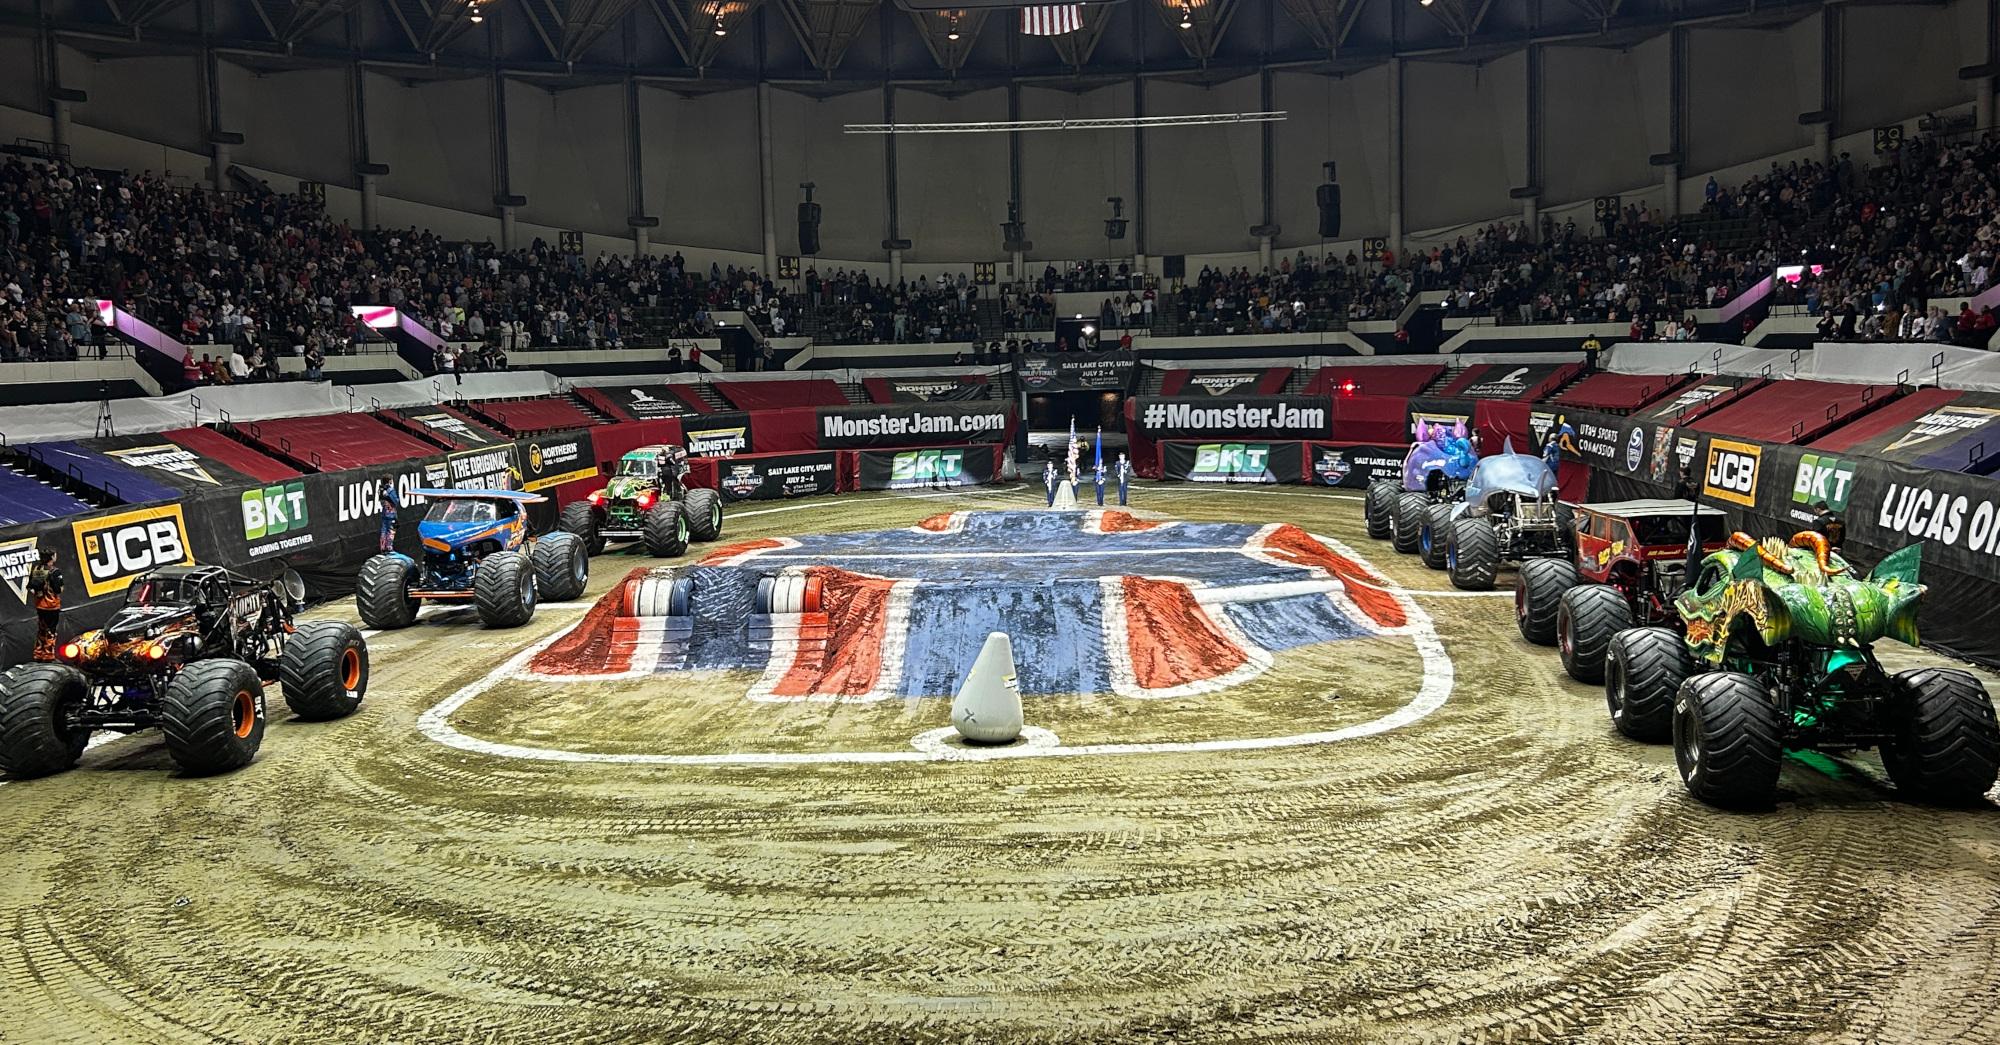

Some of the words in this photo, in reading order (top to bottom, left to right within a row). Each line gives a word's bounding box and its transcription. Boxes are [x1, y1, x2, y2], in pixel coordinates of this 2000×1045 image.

[315, 183, 323, 194] K
[562, 232, 569, 243] K
[573, 232, 580, 244] L
[1365, 240, 1373, 250] N
[780, 257, 786, 268] L
[790, 258, 798, 268] M
[976, 264, 984, 274] M
[986, 264, 994, 274] M
[1191, 376, 1255, 385] MONSTER
[1143, 403, 1325, 429] #MonsterJam
[1914, 413, 1990, 429] MONSTER
[824, 412, 1005, 438] MonsterJam.com
[1597, 428, 1618, 443] SPORTS
[542, 442, 578, 459] NORTHERN
[689, 437, 746, 453] MONSTER
[1578, 438, 1616, 459] COMMISSION
[120, 450, 200, 467] MONSTER
[452, 458, 470, 480] THE
[470, 451, 508, 476] ORIGINAL
[893, 453, 962, 475] BKT
[1196, 449, 1268, 468] BKT
[1370, 458, 1386, 466] LAKE
[1386, 459, 1403, 467] CITY,
[425, 470, 449, 482] MONSTER
[768, 468, 782, 476] SALT
[783, 467, 800, 475] LAKE
[800, 465, 816, 473] CITY,
[816, 463, 832, 471] UTAH
[1709, 452, 1755, 492] JCB
[744, 477, 763, 486] FINALS
[786, 476, 800, 485] JULY
[891, 481, 924, 489] GROWING
[1795, 463, 1853, 502] BKT
[243, 490, 304, 531] BKT
[1790, 509, 1813, 523] GROWING
[1879, 483, 1968, 545] LUCAS
[1968, 500, 2000, 557] OI
[90, 520, 184, 578] JCB
[249, 542, 279, 557] GROWING
[279, 534, 314, 550] TOGETHER
[4, 563, 29, 580] JAM
[254, 695, 264, 720] BKT
